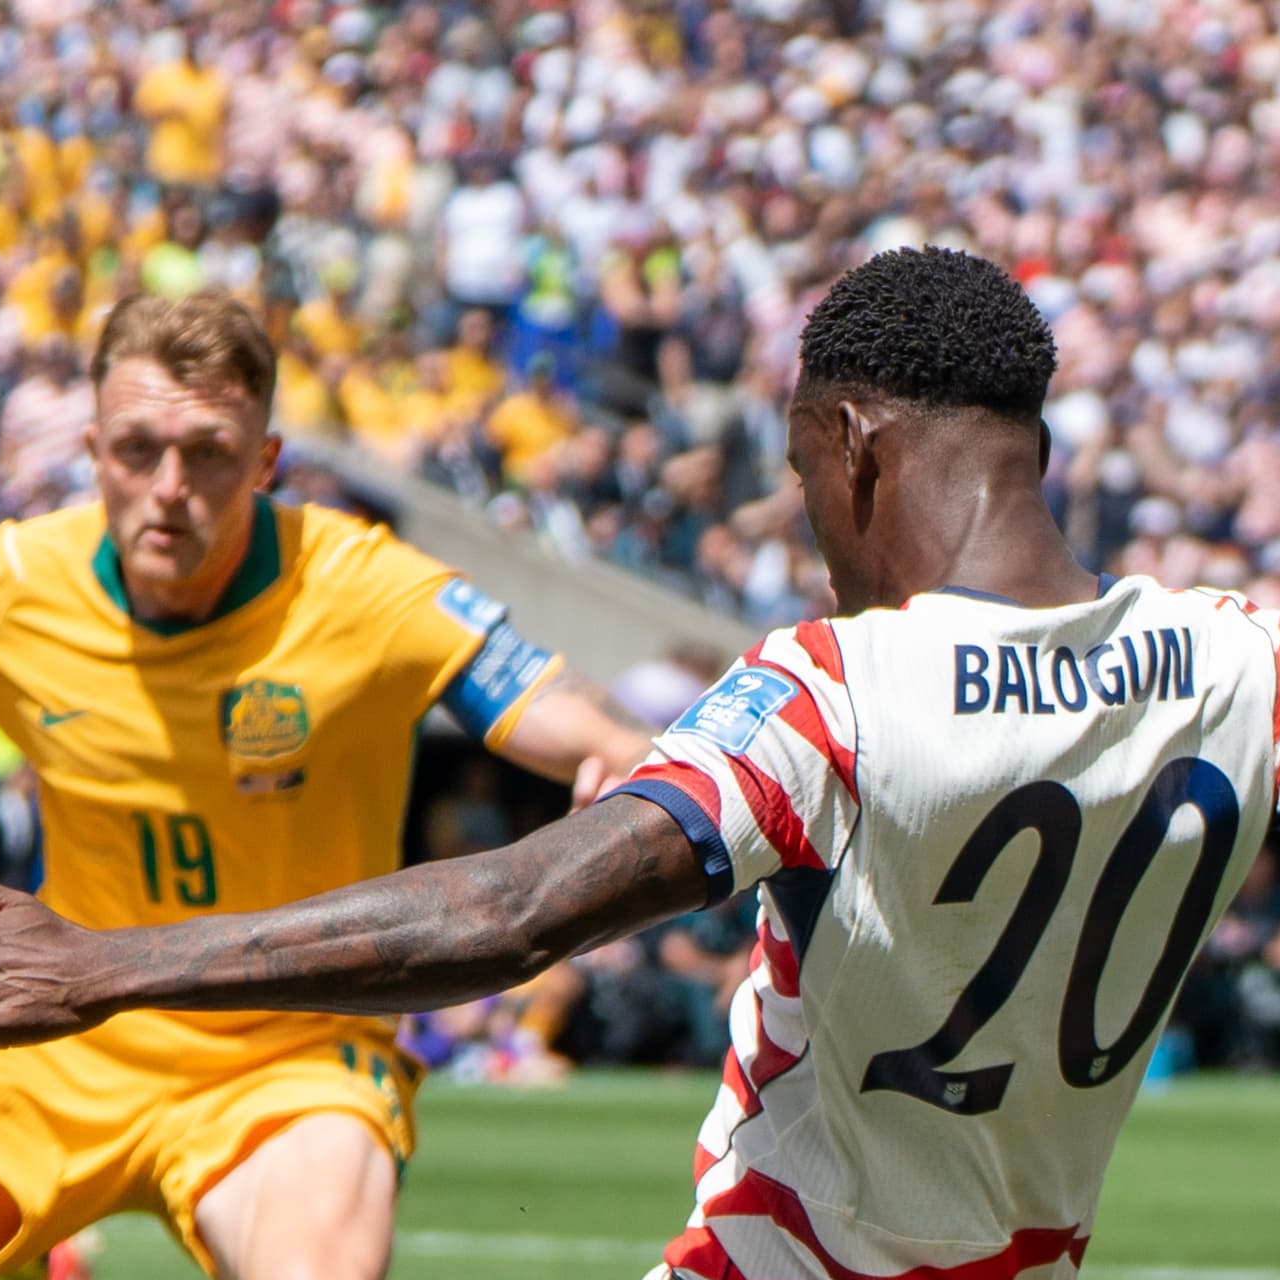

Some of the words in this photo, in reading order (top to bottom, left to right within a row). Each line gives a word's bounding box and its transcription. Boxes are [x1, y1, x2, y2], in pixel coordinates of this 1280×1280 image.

[953, 626, 1196, 716] BALOGUN
[130, 810, 219, 907] 19
[860, 756, 1241, 1116] 20
